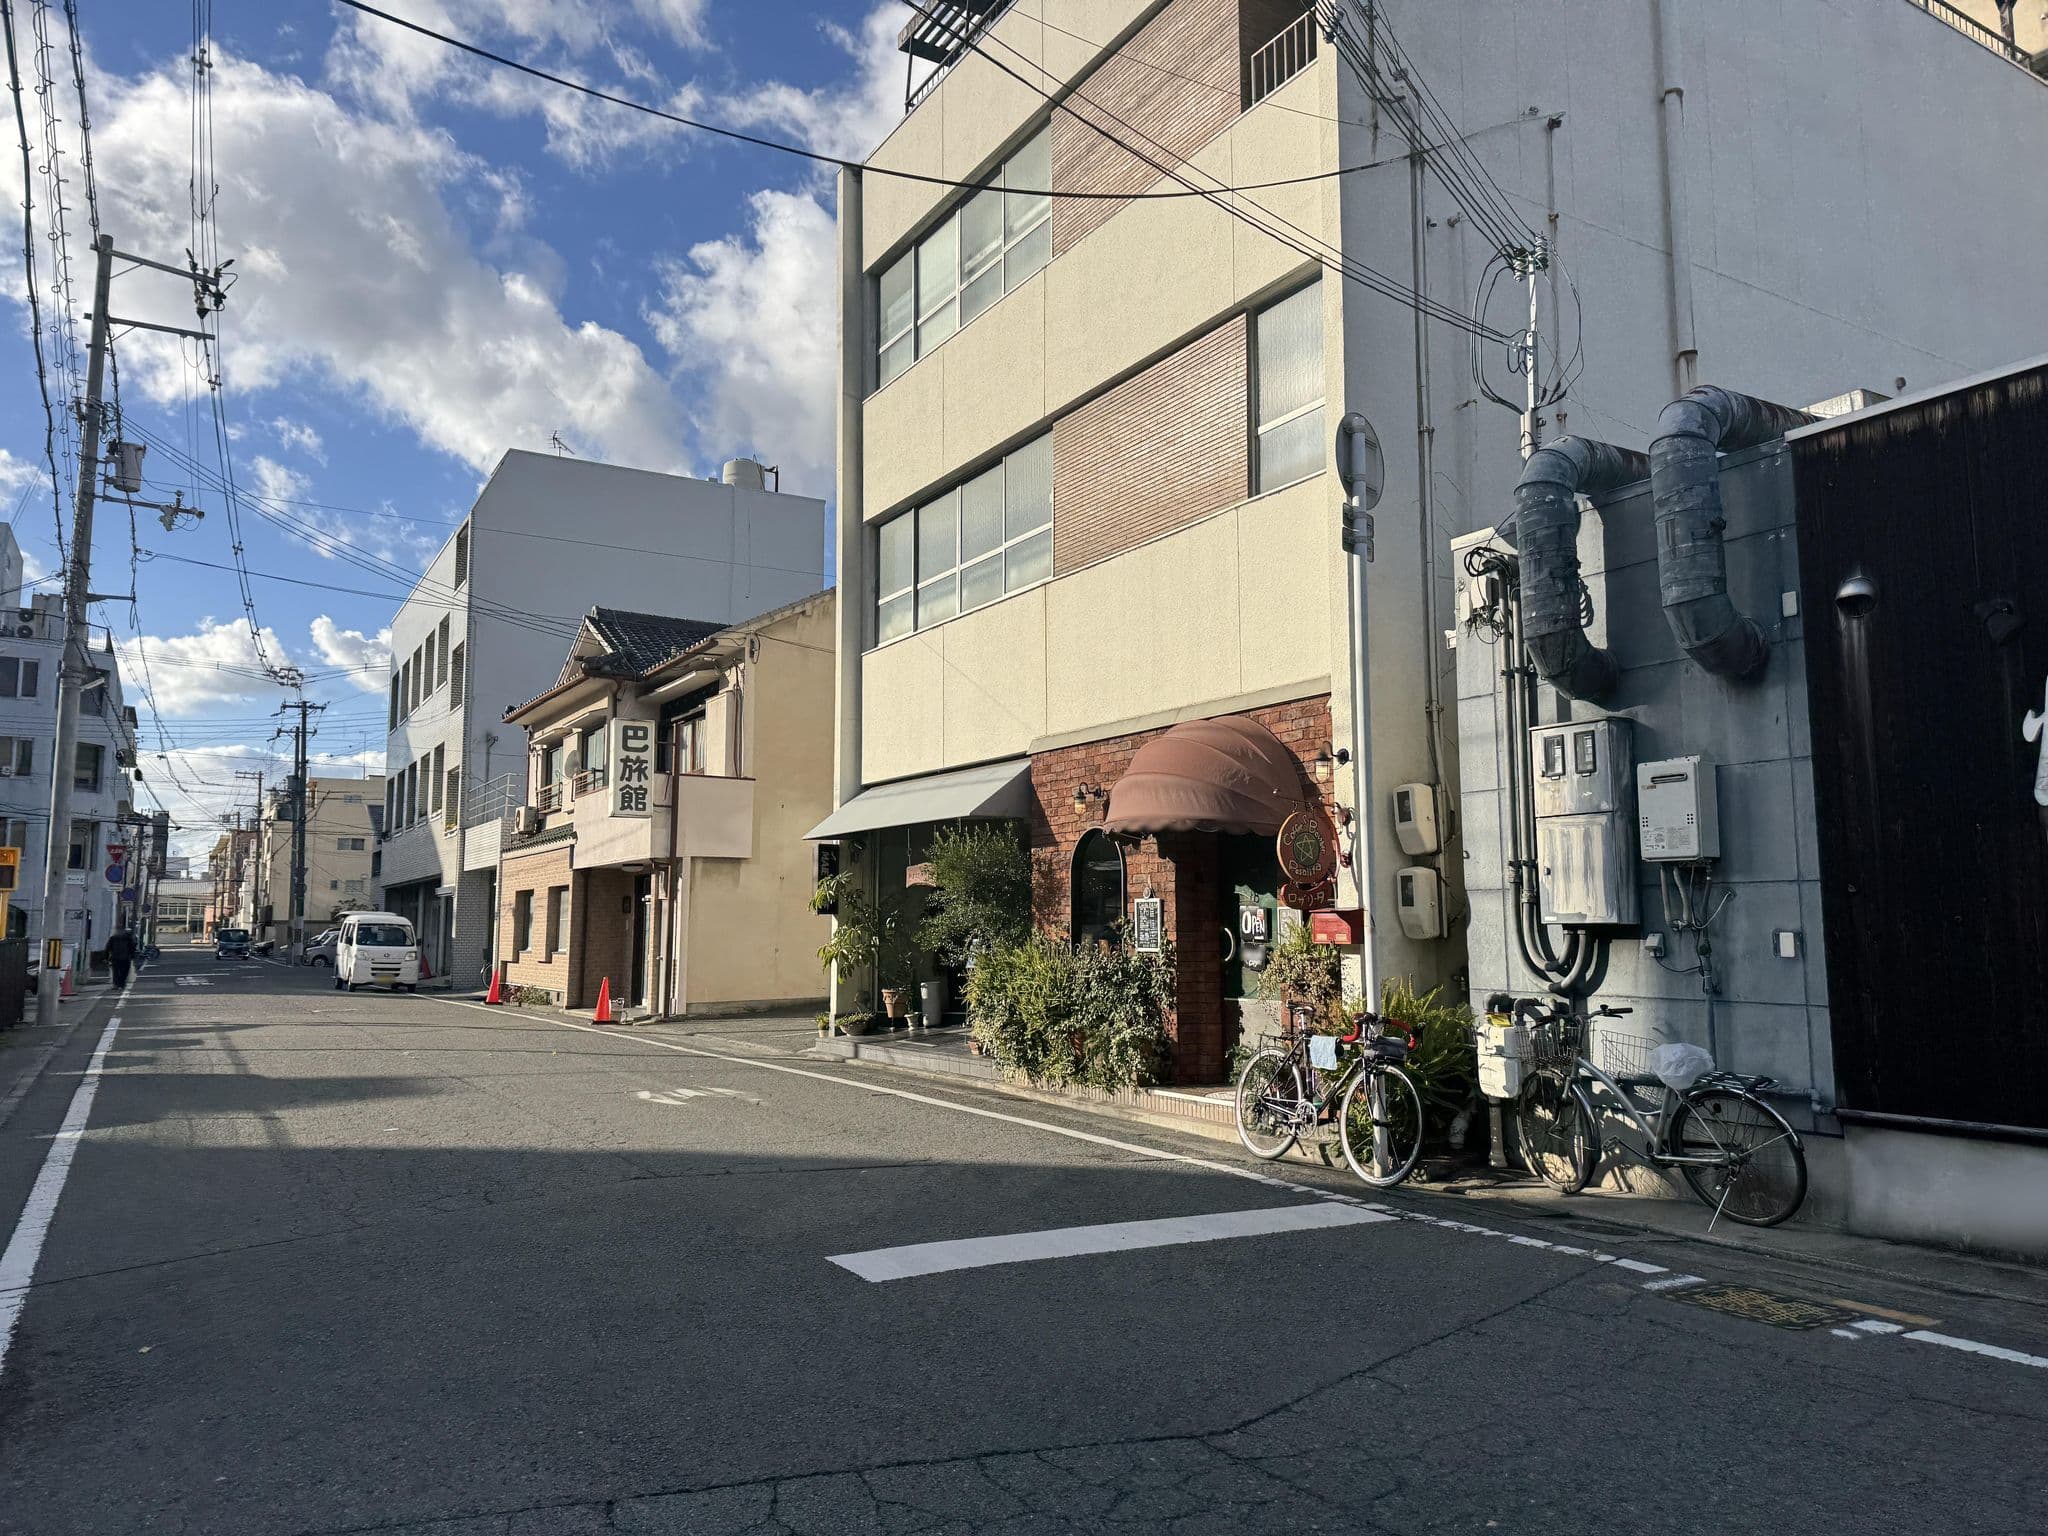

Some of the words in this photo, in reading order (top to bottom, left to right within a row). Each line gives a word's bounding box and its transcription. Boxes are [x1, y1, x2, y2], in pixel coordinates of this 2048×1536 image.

[619, 725, 649, 812] 巴旅館
[1242, 911, 1265, 935] OPEN
